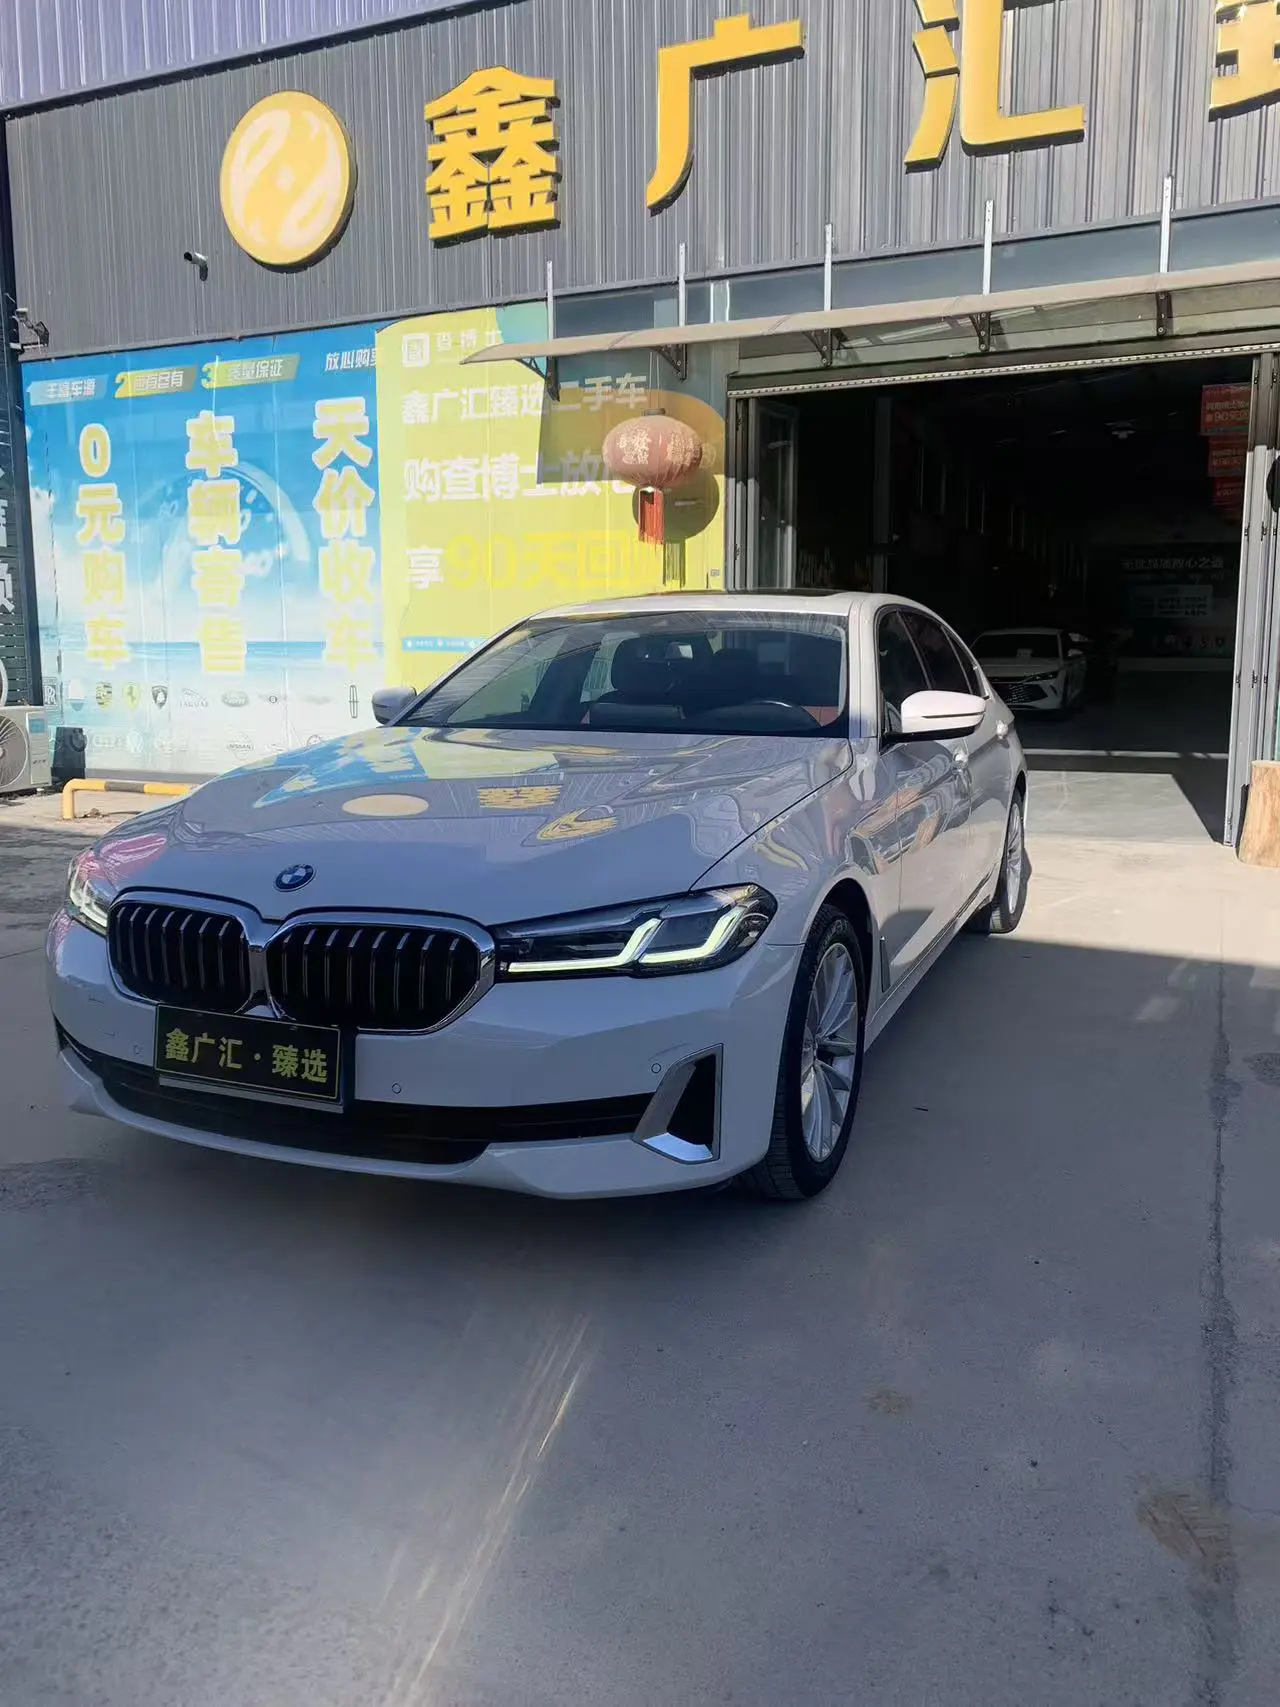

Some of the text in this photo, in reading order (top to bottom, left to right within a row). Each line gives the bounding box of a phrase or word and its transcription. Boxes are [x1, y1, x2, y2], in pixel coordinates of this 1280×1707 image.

[424, 0, 1280, 242] 鑫广汇
[402, 374, 647, 425] 鑫广汇臻选二手车
[76, 423, 130, 669] 0元购车
[312, 397, 378, 671] 天价收车
